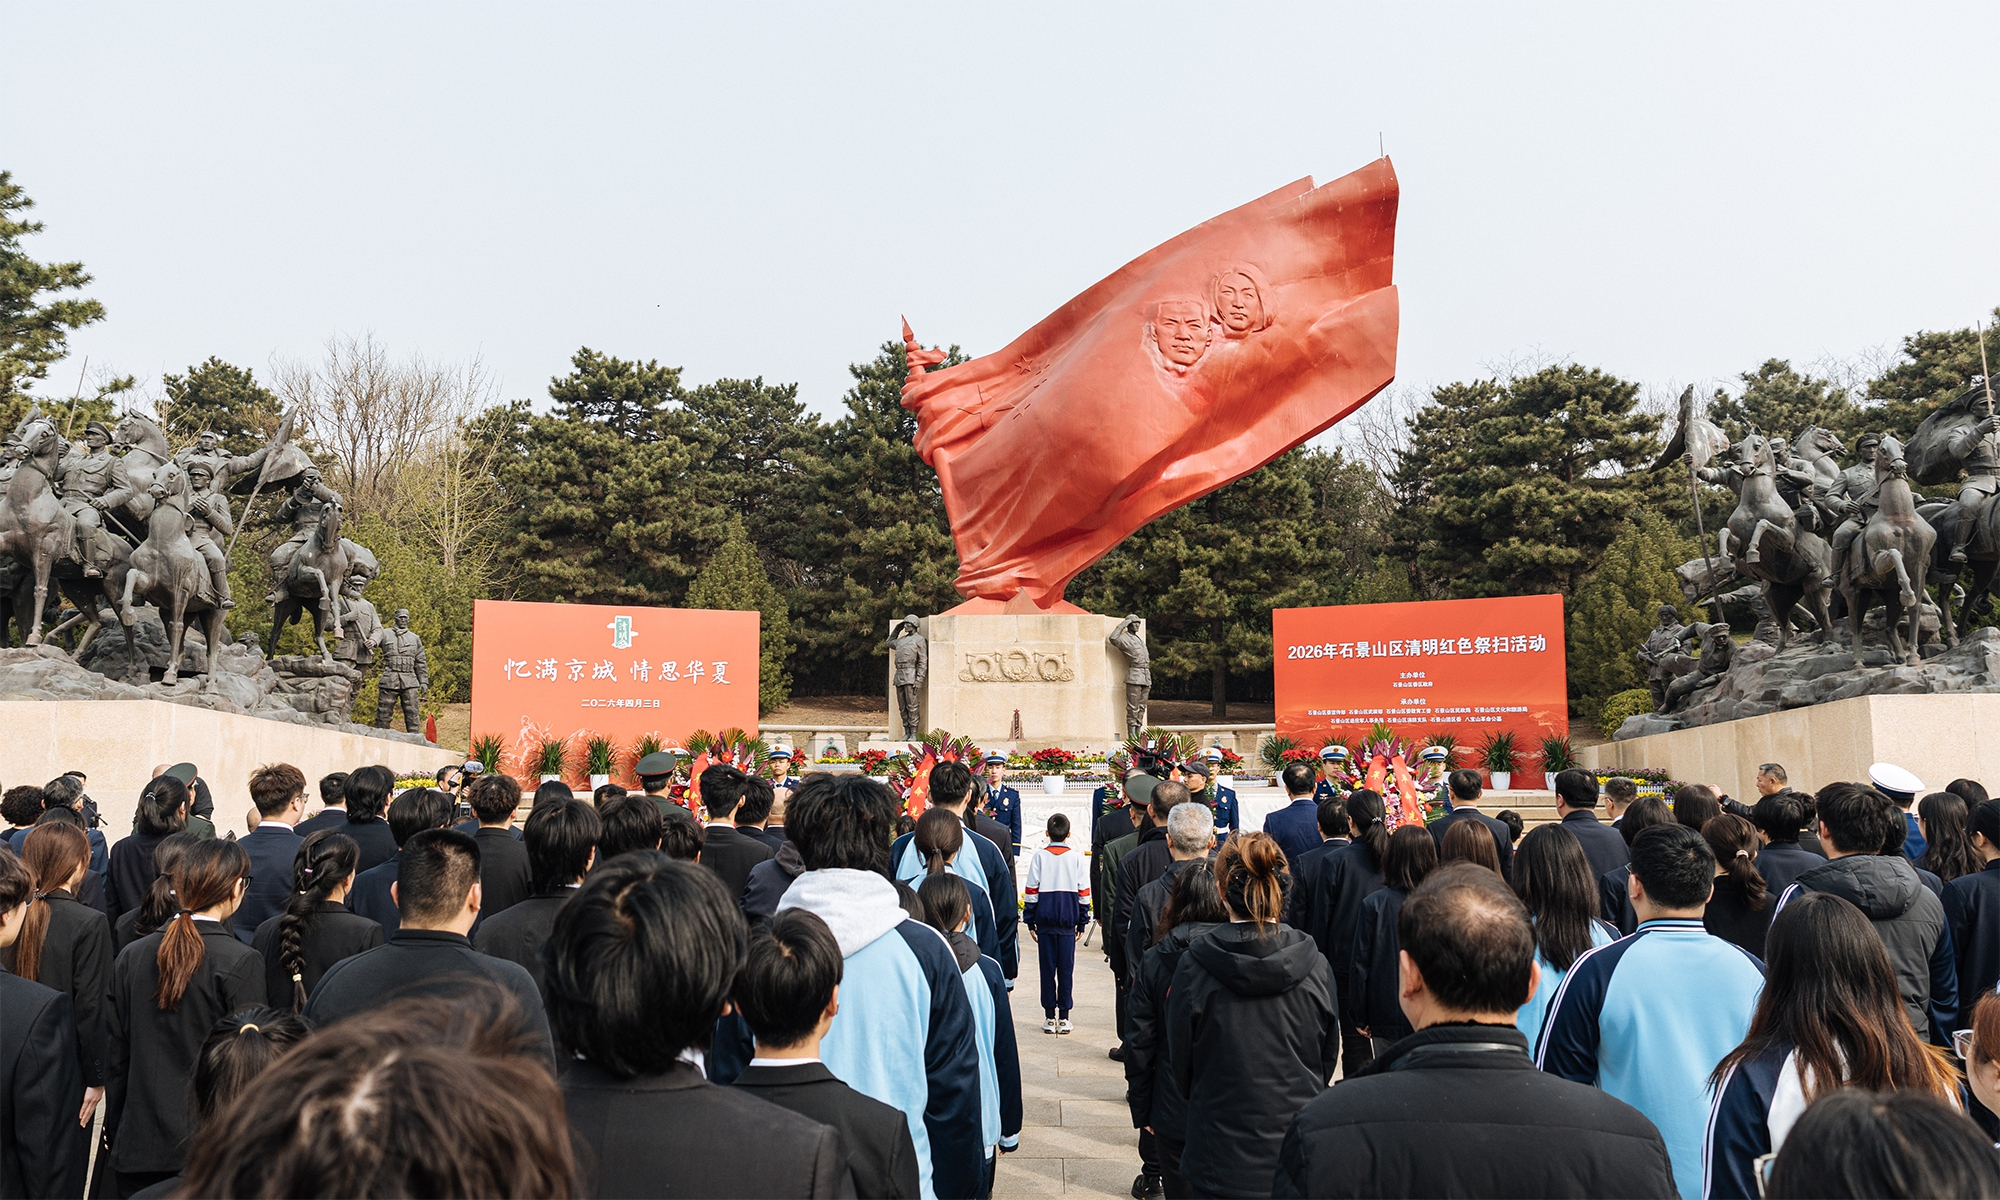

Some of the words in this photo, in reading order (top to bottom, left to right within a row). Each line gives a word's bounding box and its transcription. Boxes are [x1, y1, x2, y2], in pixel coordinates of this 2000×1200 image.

[1287, 633, 1546, 660] 2026年石景山区清明红色祭扫活动
[503, 657, 618, 683] 忆满京城
[629, 659, 731, 685] 情思华夏
[1400, 671, 1426, 679] 主办单位
[1400, 697, 1427, 706] 承办单位
